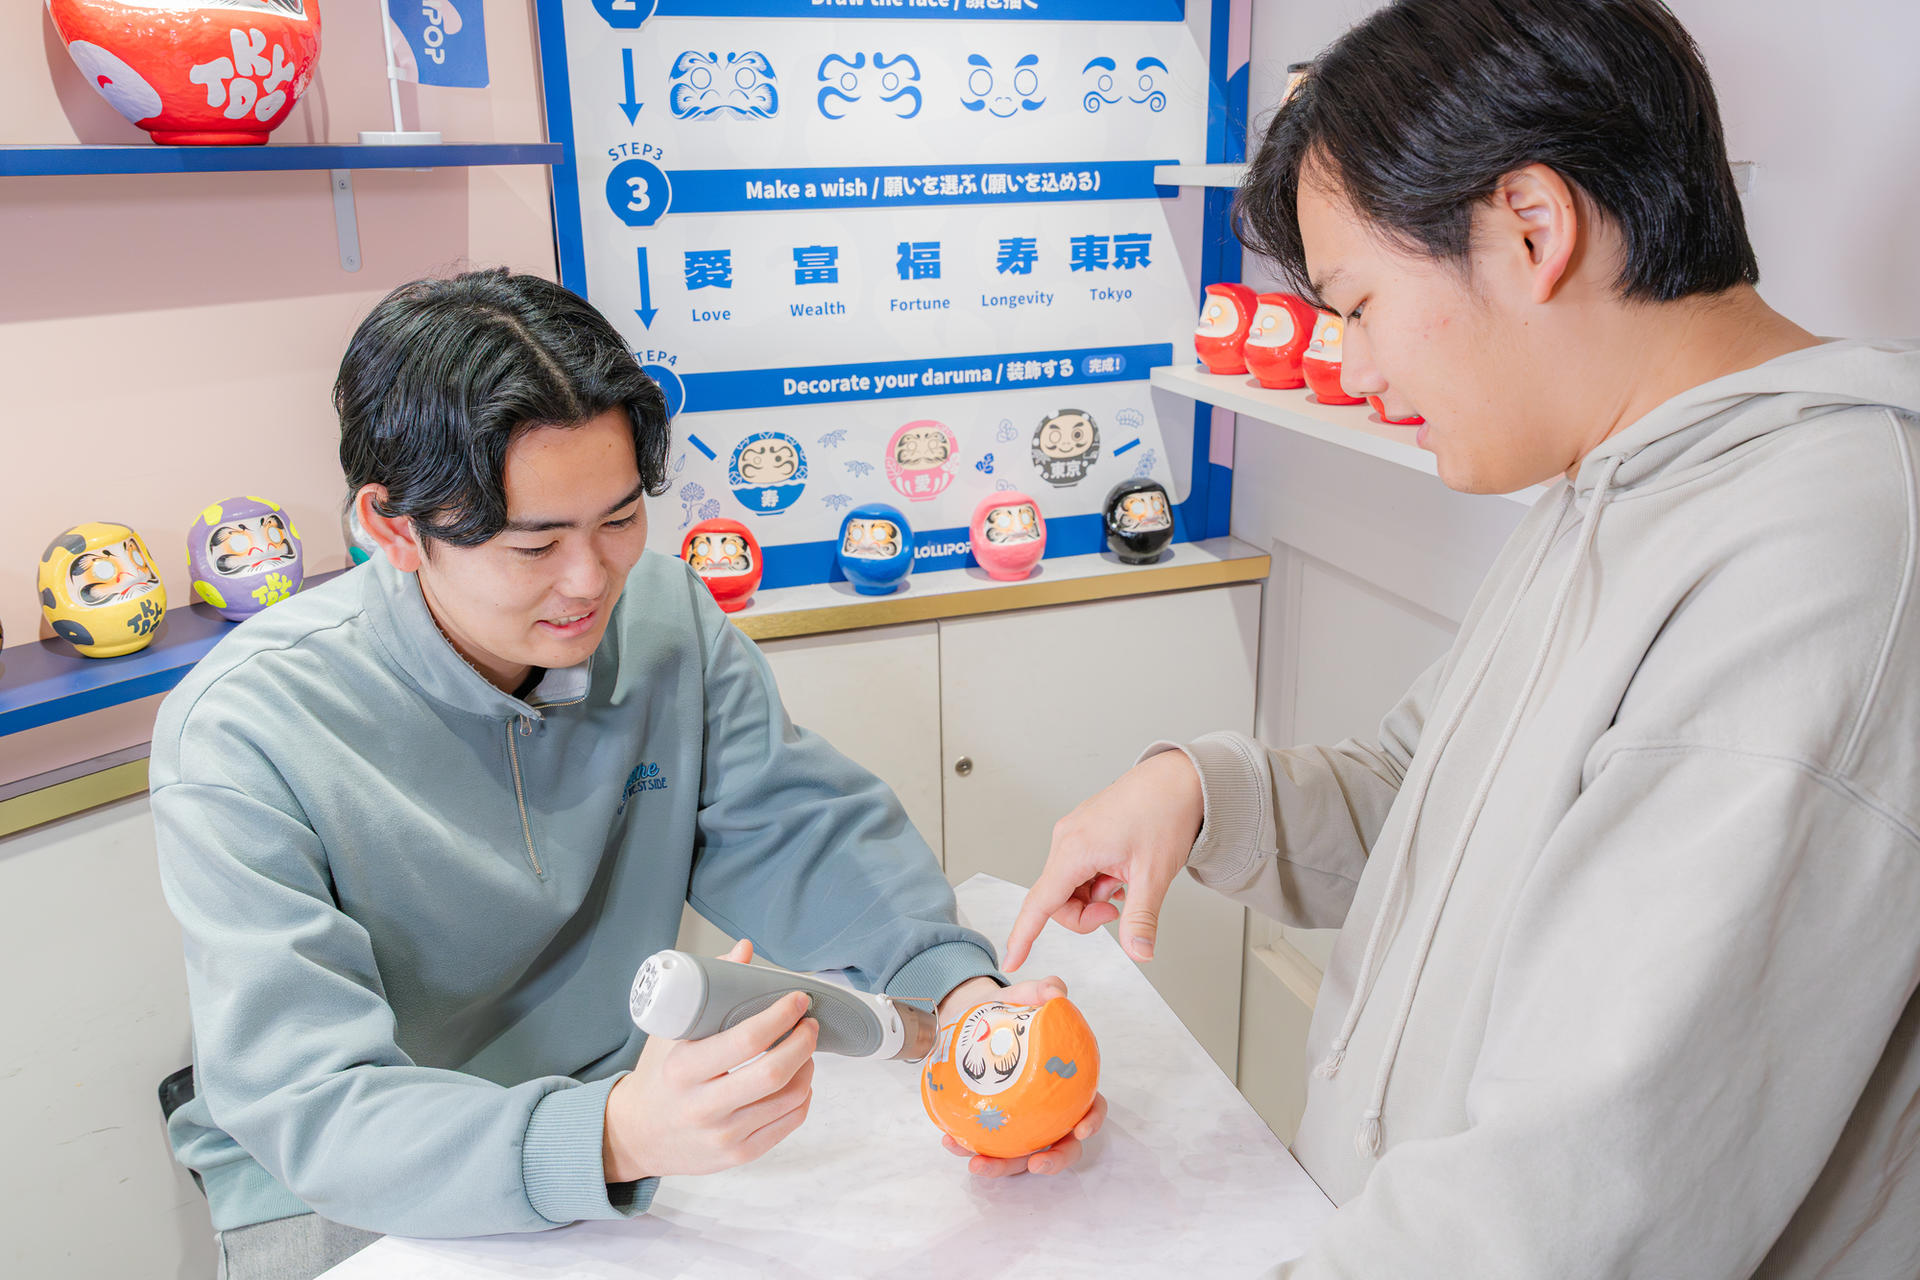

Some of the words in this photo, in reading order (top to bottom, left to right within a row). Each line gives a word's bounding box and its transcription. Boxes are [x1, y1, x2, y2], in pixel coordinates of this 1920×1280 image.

[608, 142, 663, 161] STEP3
[626, 177, 651, 212] 3
[745, 180, 800, 199] Make
[804, 183, 817, 198] a
[821, 178, 868, 197] wish
[896, 241, 941, 281] 福
[996, 237, 1038, 275] 寿
[1069, 233, 1152, 272] 東京
[684, 249, 733, 291] 愛
[793, 245, 839, 286] 富
[890, 297, 950, 312] Fortune
[981, 290, 1054, 309] Longevity
[1090, 288, 1132, 303] Tokyo
[692, 309, 731, 322] Love
[790, 301, 846, 317] Wealth
[632, 350, 677, 366] TEP4
[783, 374, 870, 396] Decorate
[874, 373, 919, 394] your
[921, 367, 993, 386] daruma
[1006, 358, 1074, 382] 装飾する
[1050, 461, 1081, 478] 東京
